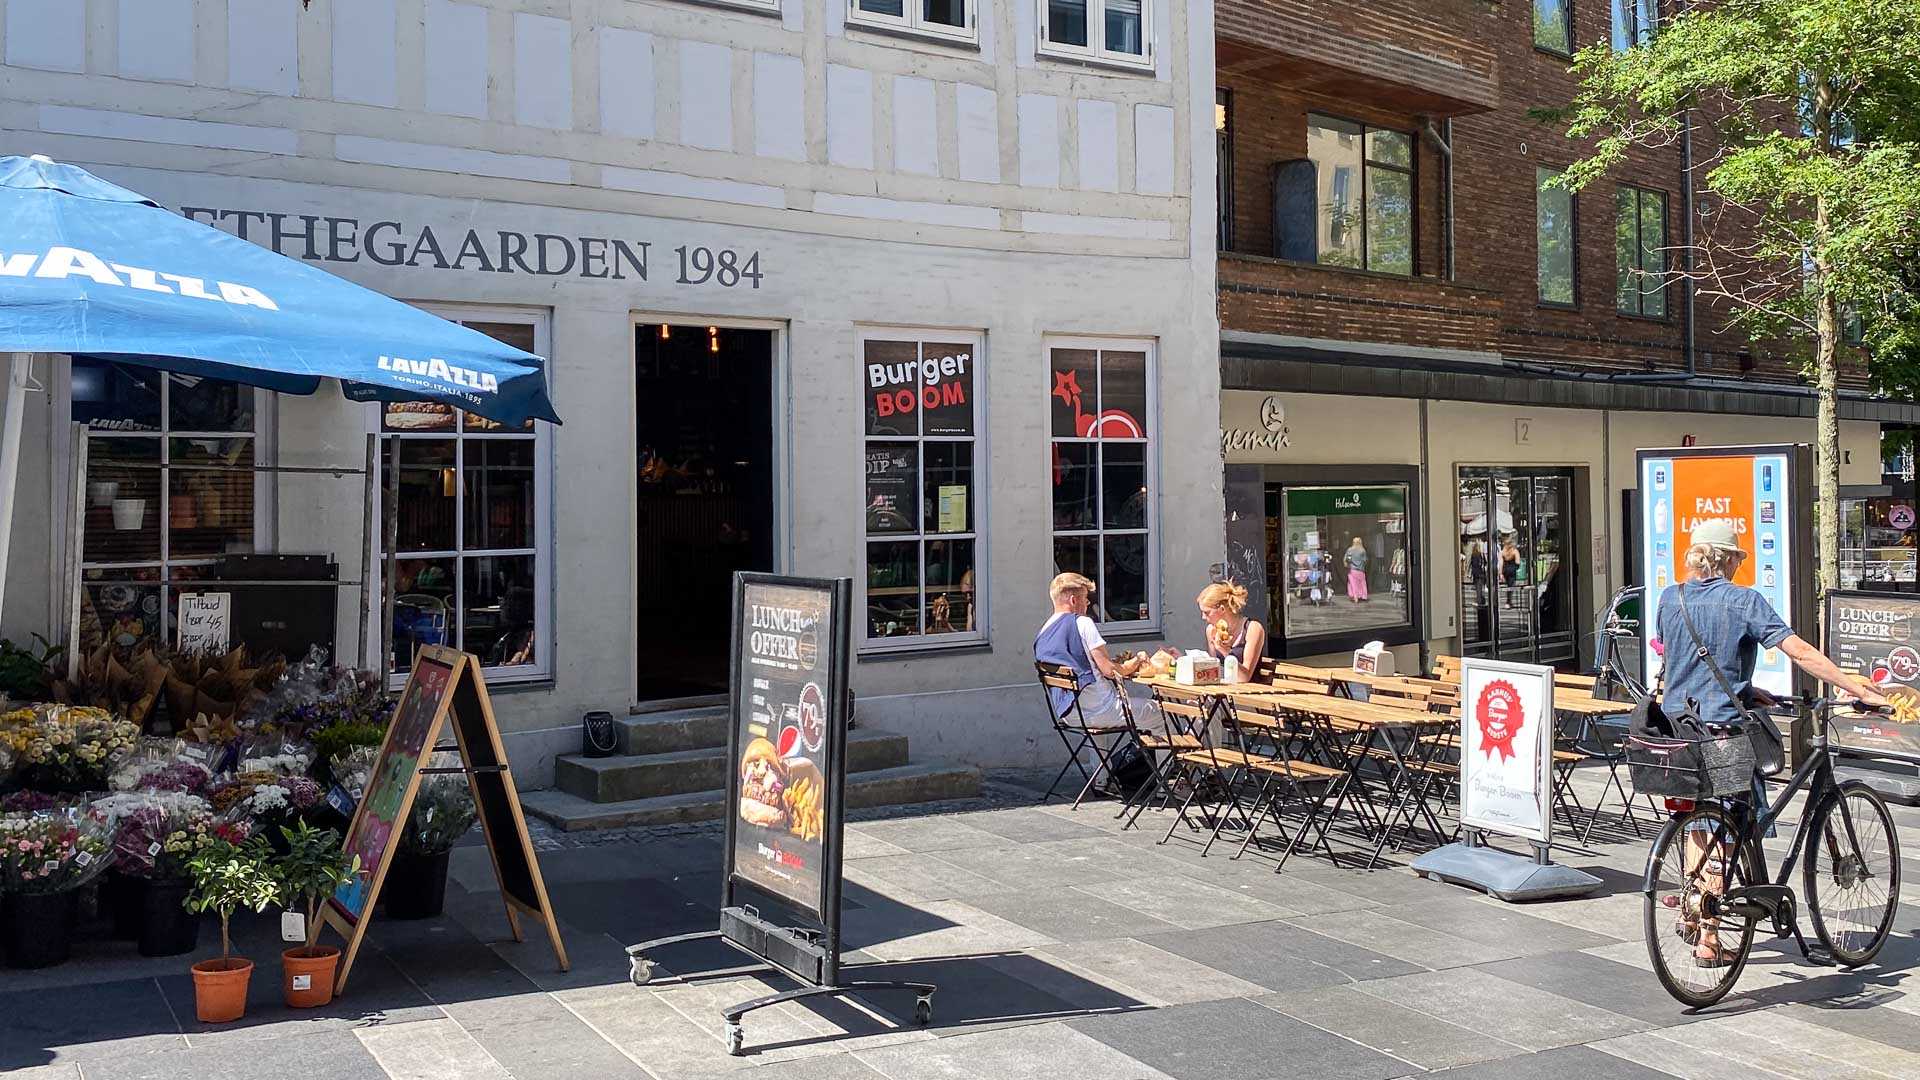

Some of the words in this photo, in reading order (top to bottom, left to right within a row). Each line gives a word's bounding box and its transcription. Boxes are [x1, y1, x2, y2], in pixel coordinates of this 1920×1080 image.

[674, 245, 764, 289] 1984
[377, 355, 499, 394] LAVAZZA
[868, 353, 970, 388] Burger
[876, 381, 966, 417] BOOM
[1521, 422, 1529, 441] 2
[1695, 497, 1732, 514] FAST
[185, 595, 221, 610] Tilbud
[1839, 607, 1896, 624] LUNCH
[751, 604, 802, 633] LUNCH
[1838, 620, 1891, 637] OFFER
[750, 630, 799, 660] OFFER
